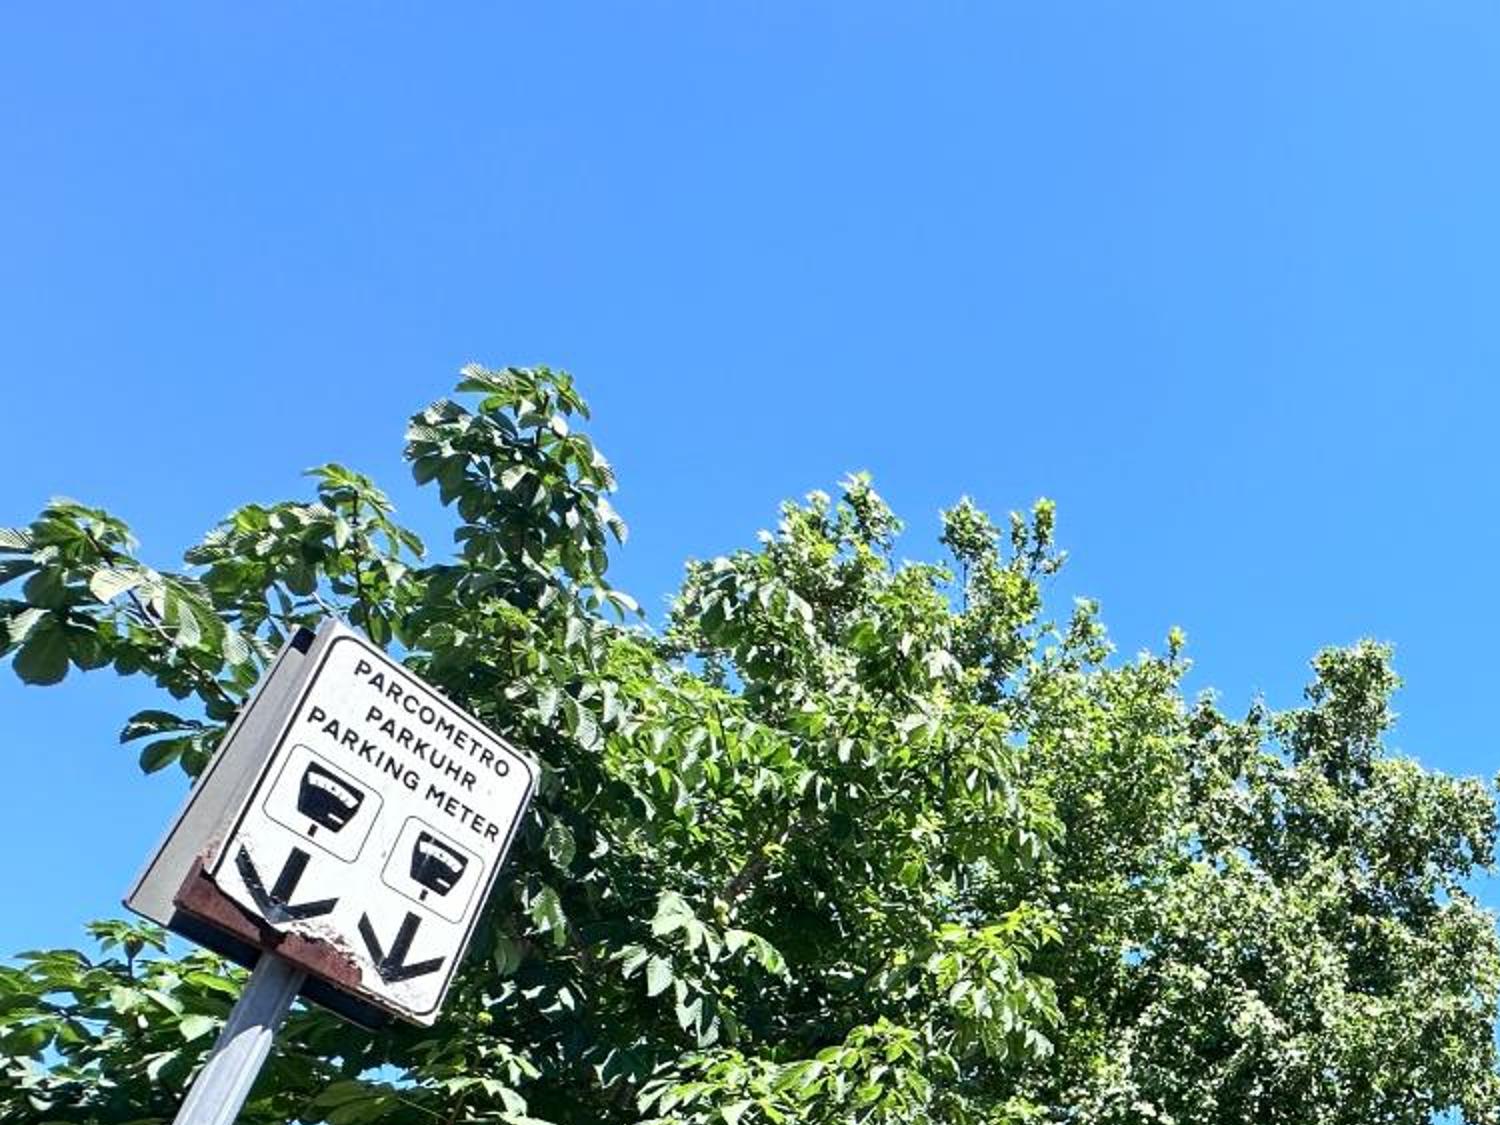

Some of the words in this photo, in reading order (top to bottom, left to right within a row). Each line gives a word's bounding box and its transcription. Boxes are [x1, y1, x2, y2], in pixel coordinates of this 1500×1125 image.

[307, 706, 419, 791] PARKING
[424, 784, 500, 842] METER
[353, 659, 510, 779] PARCOMETRO
[365, 705, 478, 792] PARKUHR
